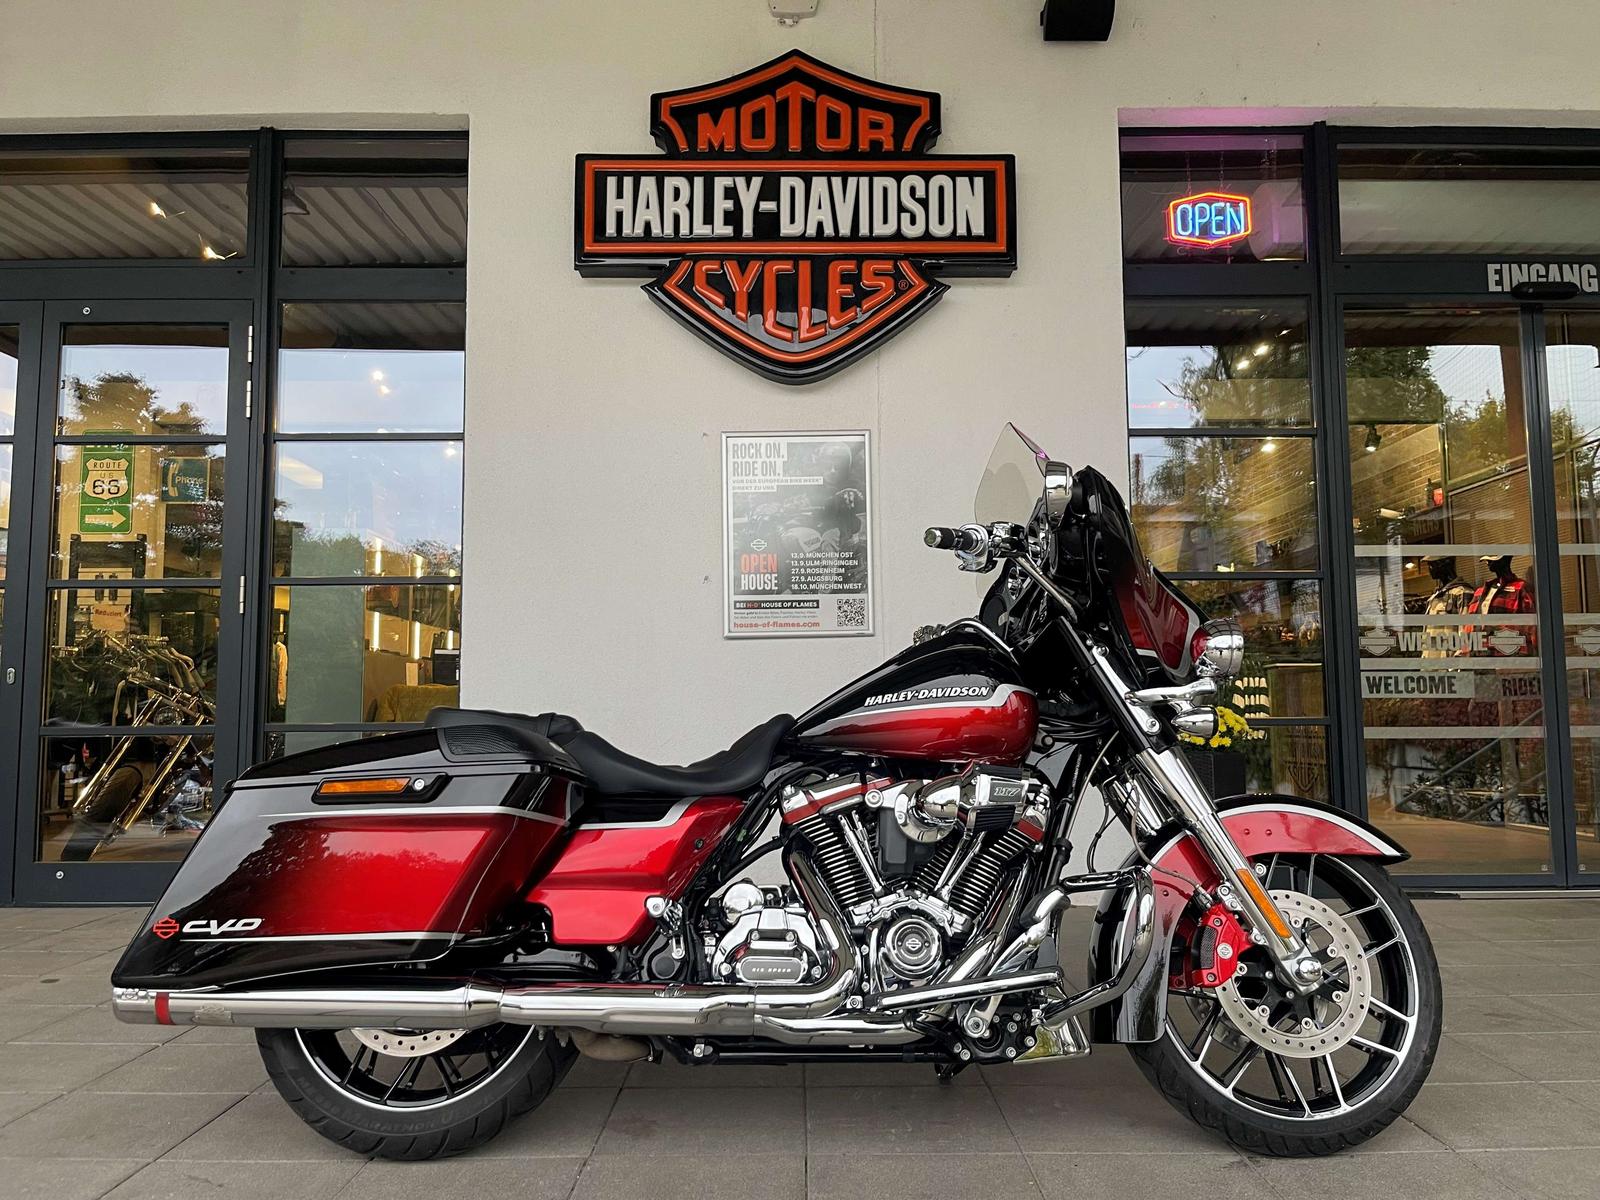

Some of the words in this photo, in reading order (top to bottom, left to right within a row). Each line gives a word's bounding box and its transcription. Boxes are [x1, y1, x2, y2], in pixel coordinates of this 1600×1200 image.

[697, 80, 894, 152] MOTOR
[605, 174, 985, 239] HARLEY-DAVIDSON
[1176, 202, 1245, 236] OPEN
[1487, 263, 1599, 293] EINGANG
[693, 259, 896, 343] CYCLES
[732, 443, 763, 459] ROCK
[765, 442, 784, 459] ON.
[93, 461, 122, 469] ROUTE
[732, 460, 759, 477] RIDE
[761, 460, 780, 476] ON.
[92, 479, 120, 495] 66
[740, 553, 778, 573] OPEN
[740, 573, 778, 590] HOUSE
[809, 582, 843, 590] MÜNCHEN
[733, 620, 820, 629] house-of-flames.com
[1398, 631, 1488, 651] WELCOME
[1365, 675, 1457, 695] WELCOME
[864, 686, 990, 707] HARLEY-DAVIDSON
[994, 786, 1021, 797] 117
[182, 917, 263, 935] CVO
